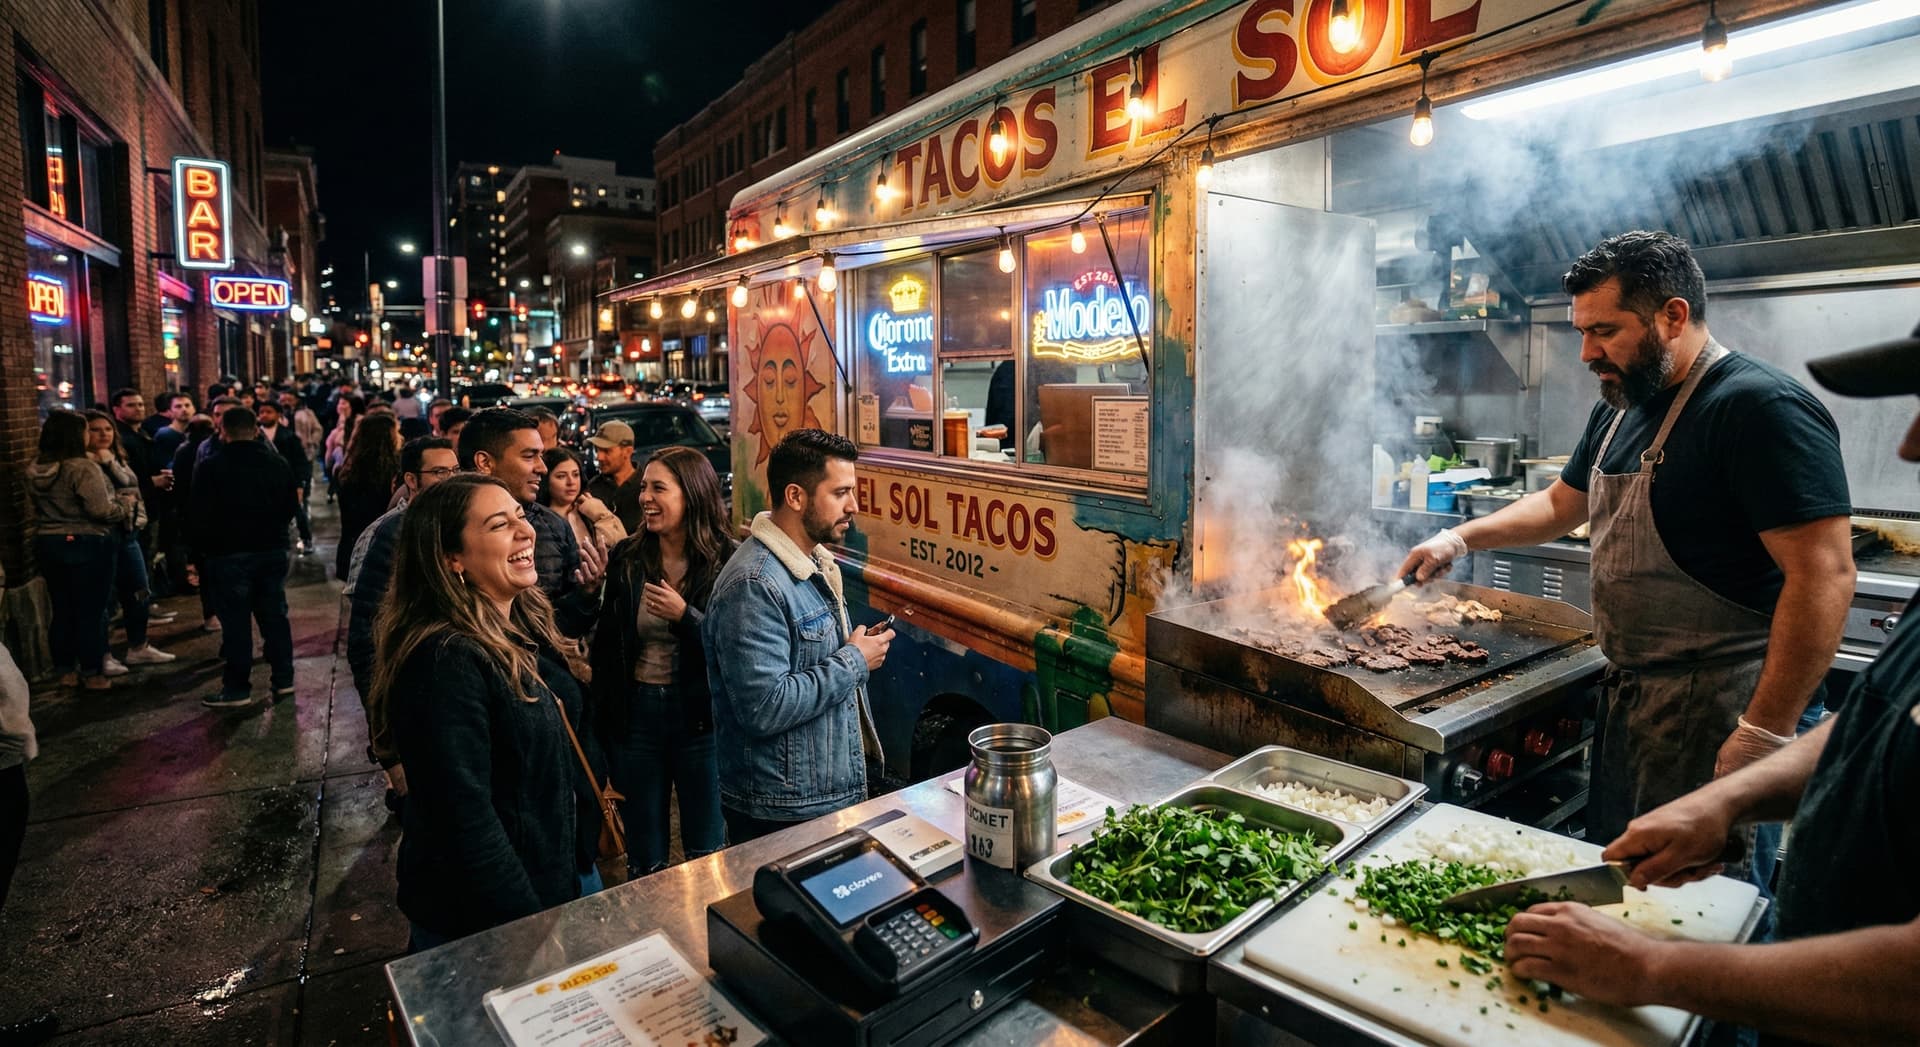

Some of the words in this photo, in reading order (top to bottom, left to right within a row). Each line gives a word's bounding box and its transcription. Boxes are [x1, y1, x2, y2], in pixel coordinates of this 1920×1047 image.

[897, 86, 1058, 211] TACOS
[1088, 43, 1188, 154] EL
[1234, 0, 1482, 107] SOL
[184, 166, 220, 260] BAR
[213, 281, 285, 306] OPEN
[1073, 271, 1093, 291] EST
[1045, 281, 1149, 340] Modelo
[887, 346, 927, 373] Extra
[857, 476, 882, 516] EL
[889, 482, 939, 531] SOL
[946, 492, 1056, 558] TACOS
[946, 547, 984, 579] 2012
